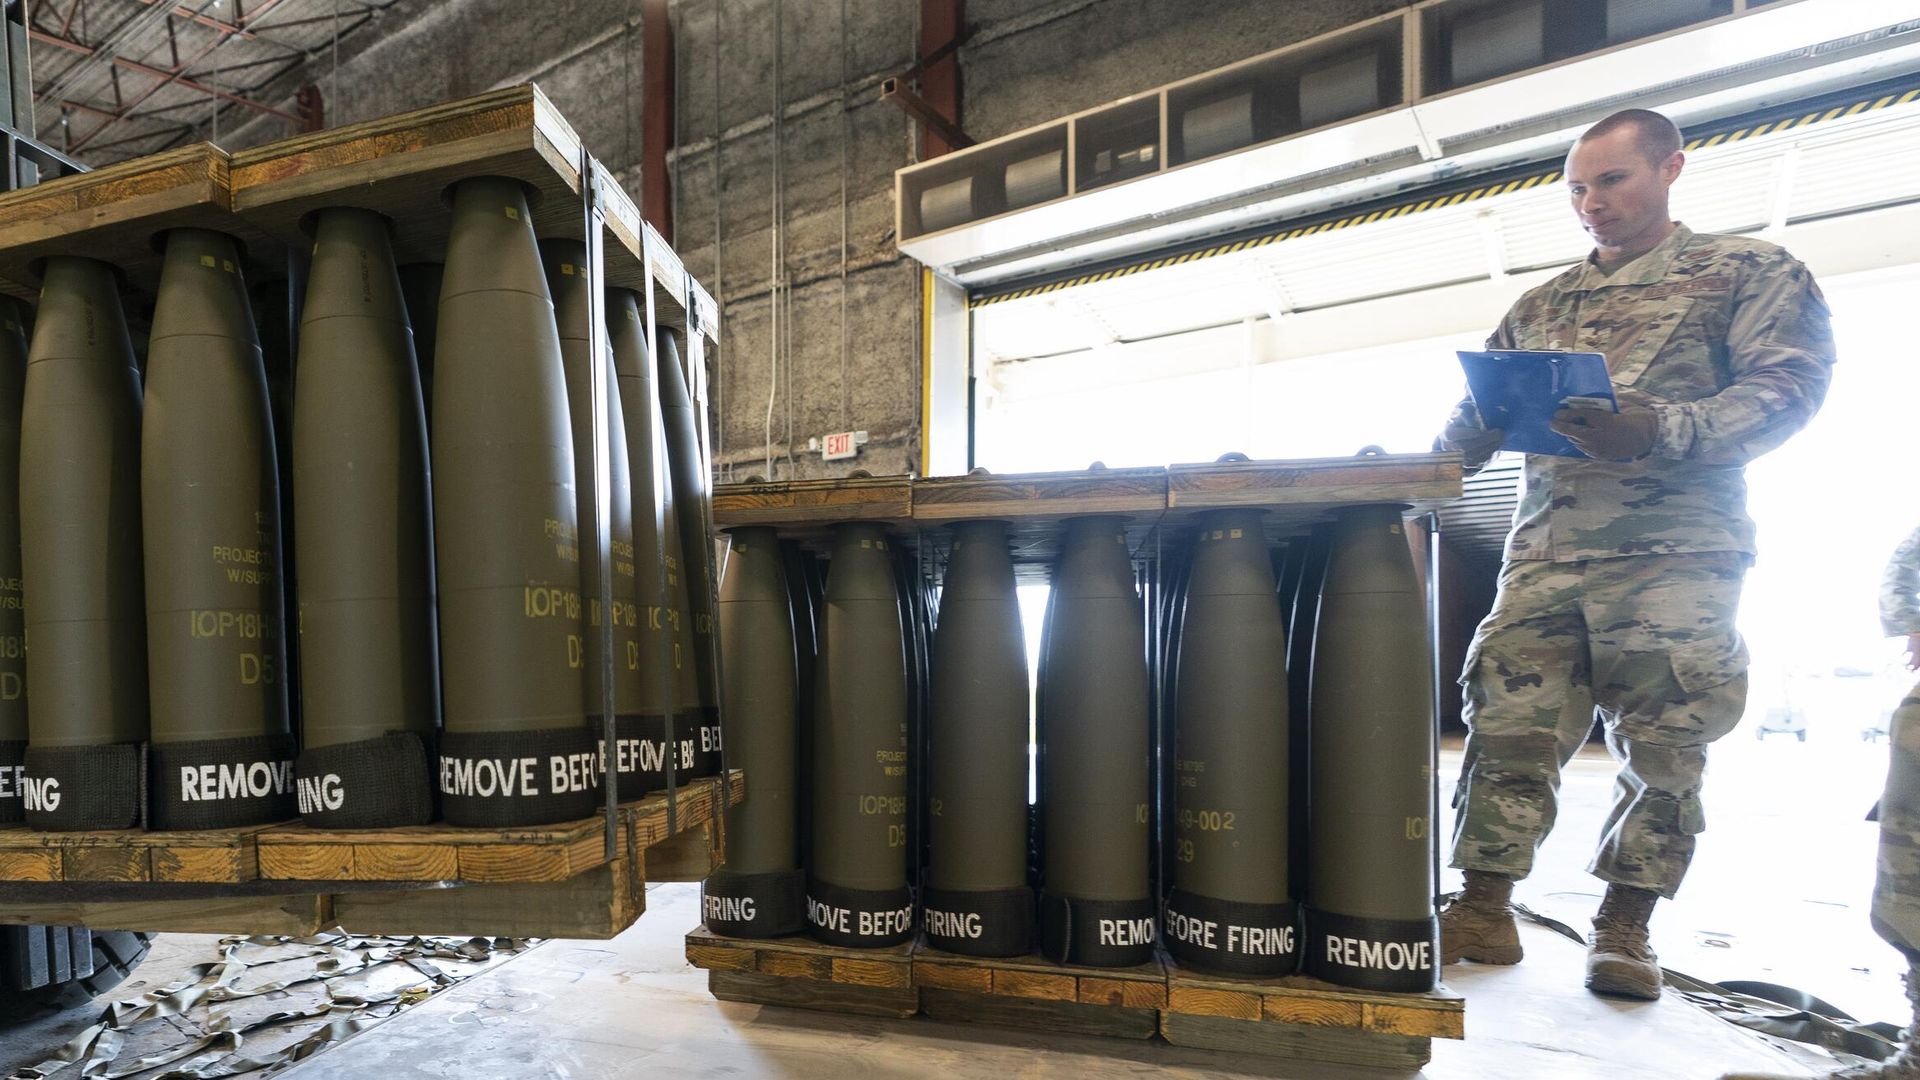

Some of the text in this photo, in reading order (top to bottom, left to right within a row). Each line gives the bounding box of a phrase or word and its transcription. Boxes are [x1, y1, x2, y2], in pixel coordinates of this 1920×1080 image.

[827, 434, 849, 455] EXIT
[180, 760, 294, 801] REMOVE
[440, 756, 538, 797] REMOVE
[297, 773, 344, 813] ING
[703, 894, 756, 922] FIRING
[924, 907, 983, 939] FIRING
[1099, 917, 1155, 946] REMO
[1227, 925, 1295, 955] FIRING
[1326, 934, 1431, 971] REMOVE
